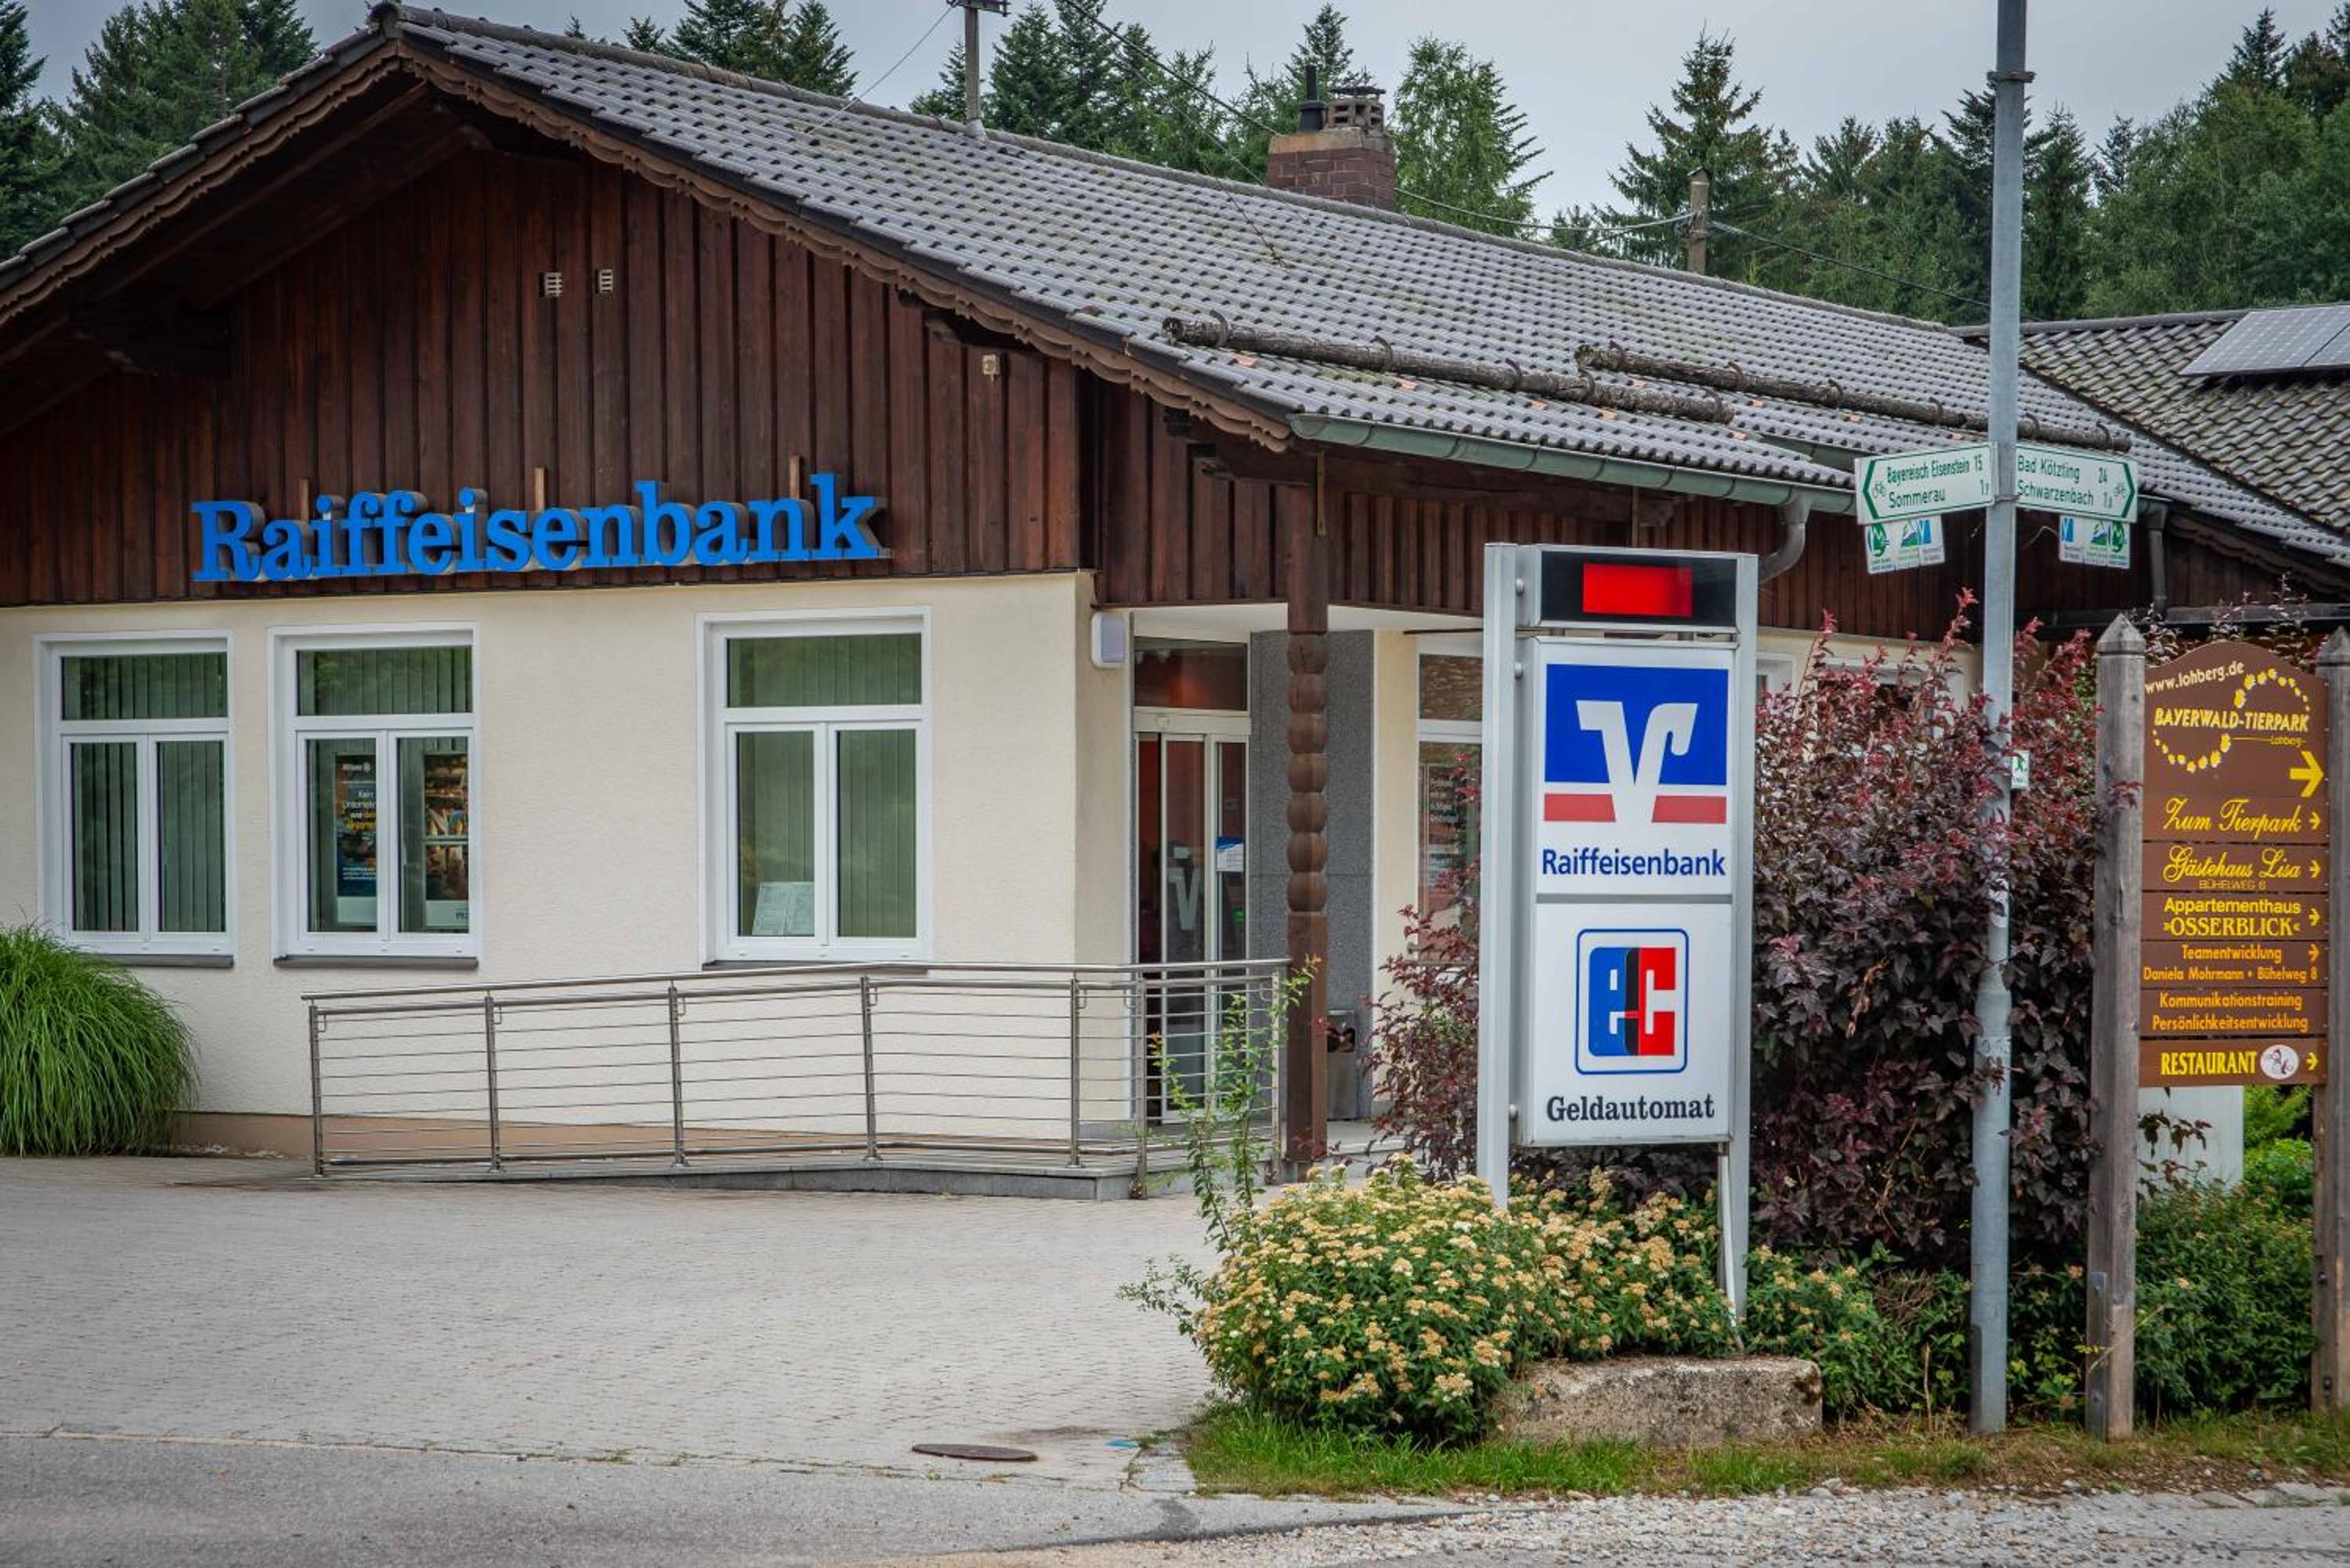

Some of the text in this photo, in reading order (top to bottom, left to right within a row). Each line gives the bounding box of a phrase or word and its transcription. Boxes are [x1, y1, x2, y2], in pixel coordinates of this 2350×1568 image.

[1931, 457, 1970, 477] Eisenstein
[1974, 454, 1983, 471] 15
[2017, 455, 2037, 473] Bad
[1889, 489, 1946, 508] Sommerau
[2017, 479, 2094, 506] Schwarzenbach
[190, 472, 891, 584] Raiffeisenbank
[2145, 660, 2244, 694] www.lohberg.de
[2154, 707, 2308, 732] BAYERWALD-TIERPARK
[2163, 797, 2301, 840] Zum Tierpark
[1542, 847, 1726, 876] Raiffeisenbank
[2163, 845, 2301, 883] Gästehaus Lisa
[2164, 898, 2301, 916] Appartementhaus
[2182, 944, 2282, 963] Teamentwicklung
[2143, 966, 2184, 980] Daniela
[2189, 966, 2244, 980] Mohrmann
[2257, 966, 2307, 984] Bühelweg
[2160, 991, 2302, 1010] Kommunikationstraining
[2153, 1013, 2308, 1033] Persönlichkeitsentwicklung
[2160, 1051, 2258, 1075] RESTAURANT
[1546, 1093, 1715, 1122] Geldautomat
